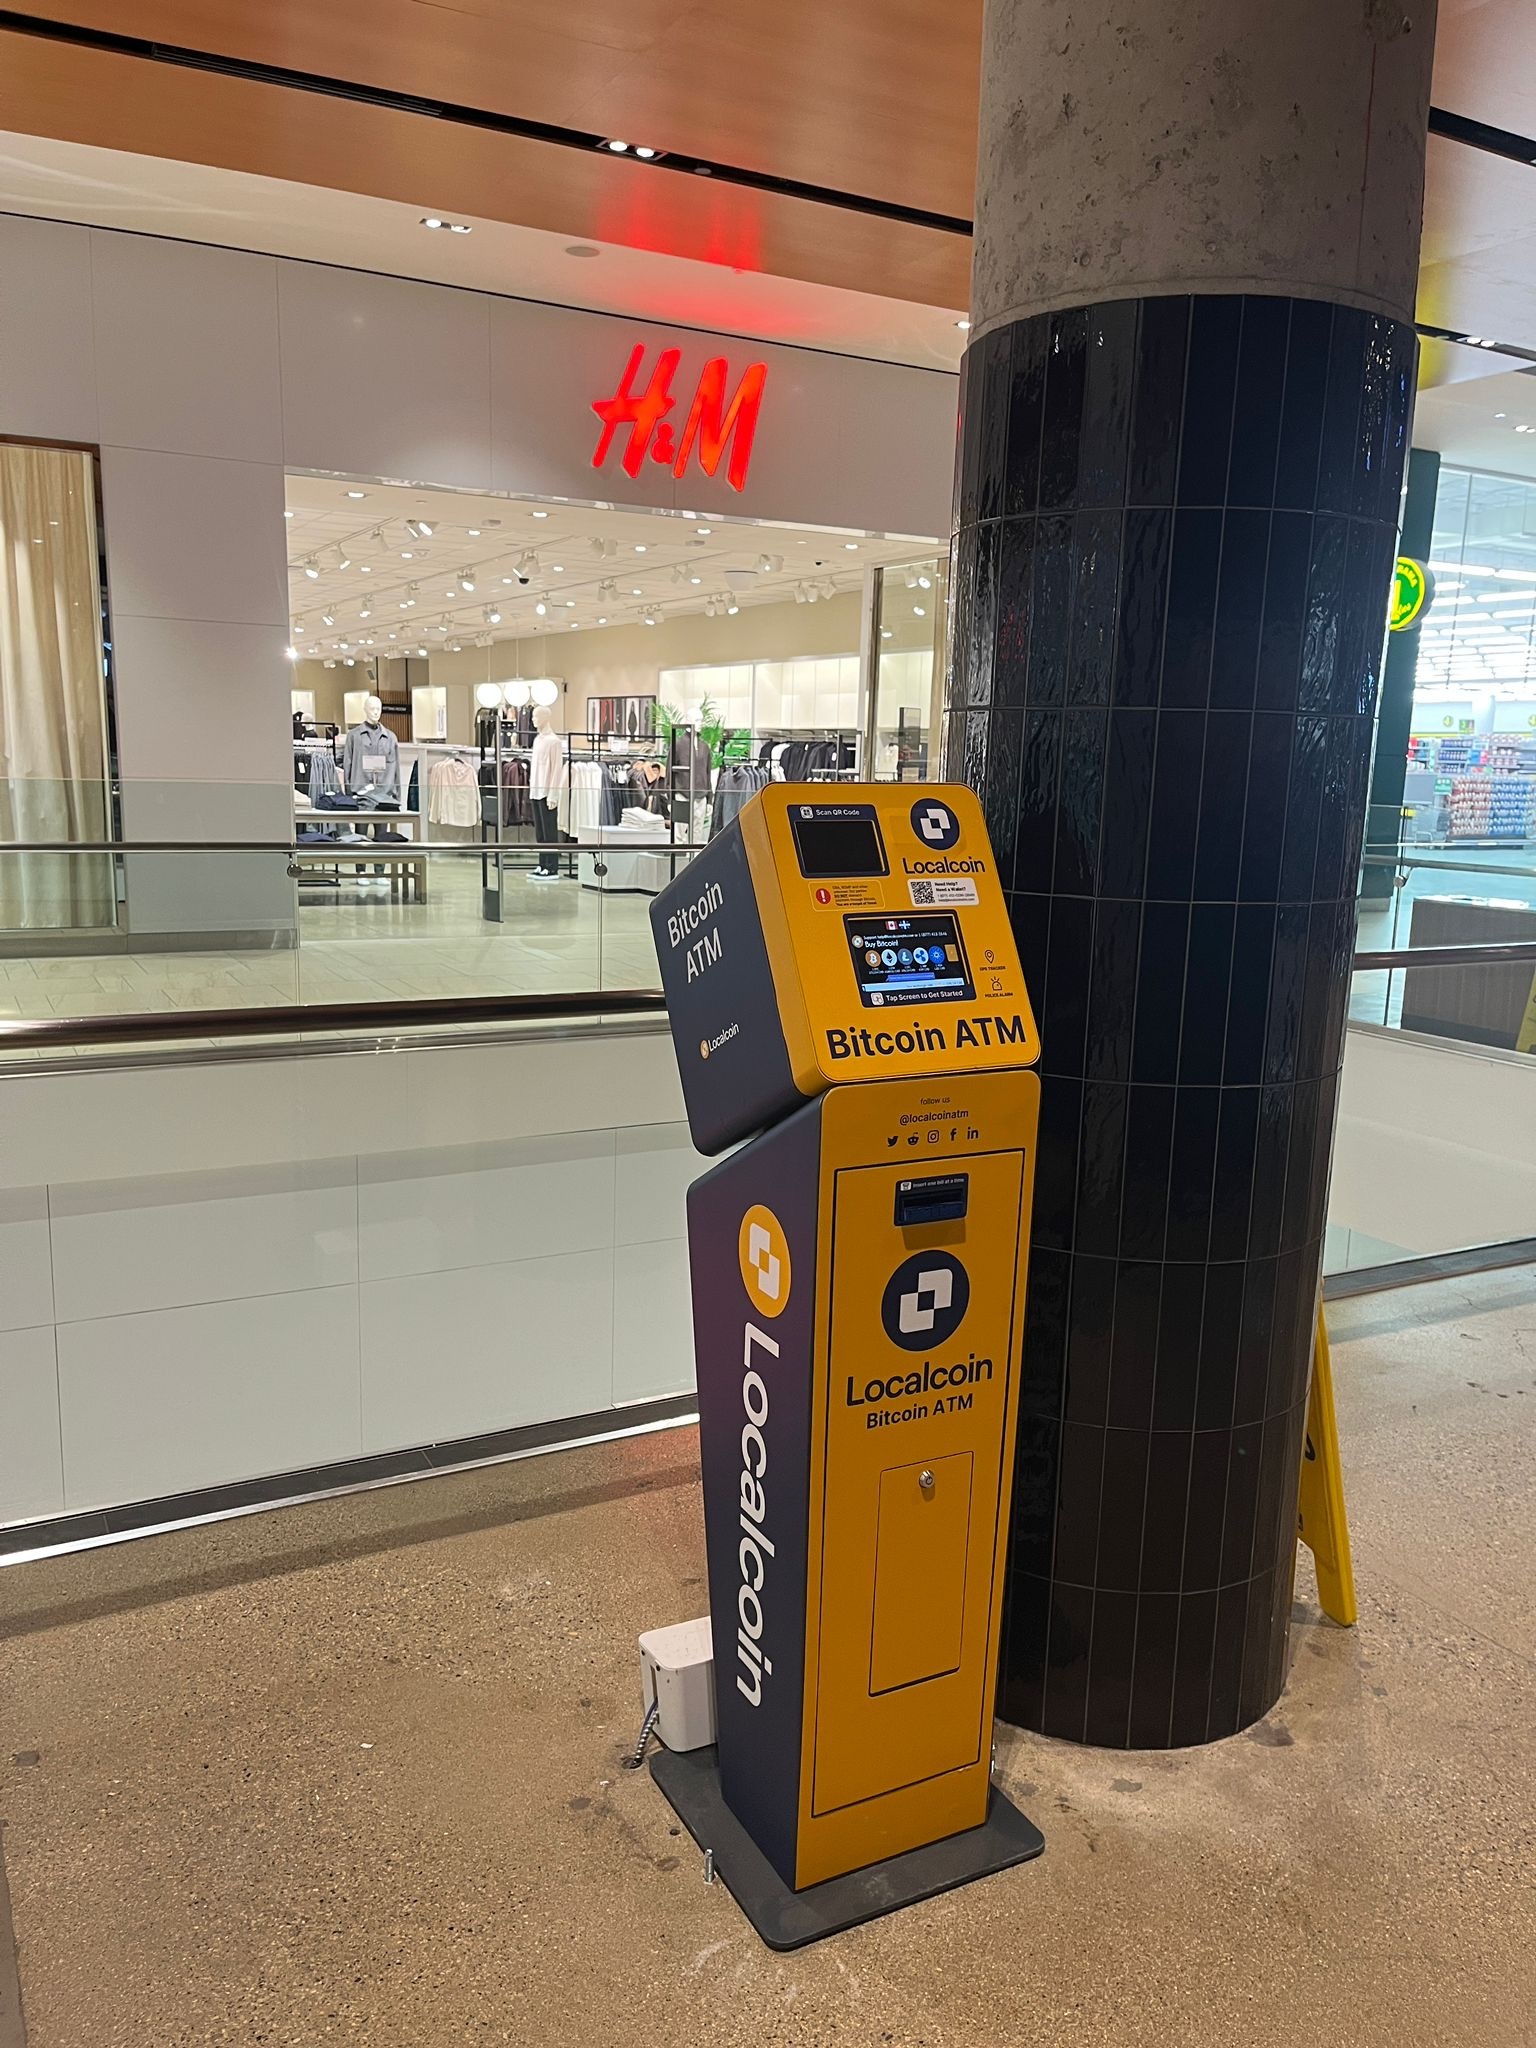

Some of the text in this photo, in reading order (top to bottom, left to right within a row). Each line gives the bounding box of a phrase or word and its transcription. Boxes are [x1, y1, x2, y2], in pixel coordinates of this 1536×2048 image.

[590, 342, 769, 493] H&M
[902, 856, 986, 875] Localcoin
[666, 881, 724, 949] Bitcoin
[685, 926, 724, 984] ATM
[898, 993, 920, 1001] Screen
[928, 991, 940, 999] Get
[940, 990, 963, 998] Started
[707, 1022, 740, 1053] Localcoin
[825, 1014, 1027, 1061] Bitcoin ATM
[899, 1109, 969, 1126] @localcoinatm
[920, 1097, 941, 1105] follow
[846, 1353, 993, 1407] Localcoin
[866, 1393, 973, 1430] Bitcoin ATM
[735, 1322, 780, 1707] Localcoin
